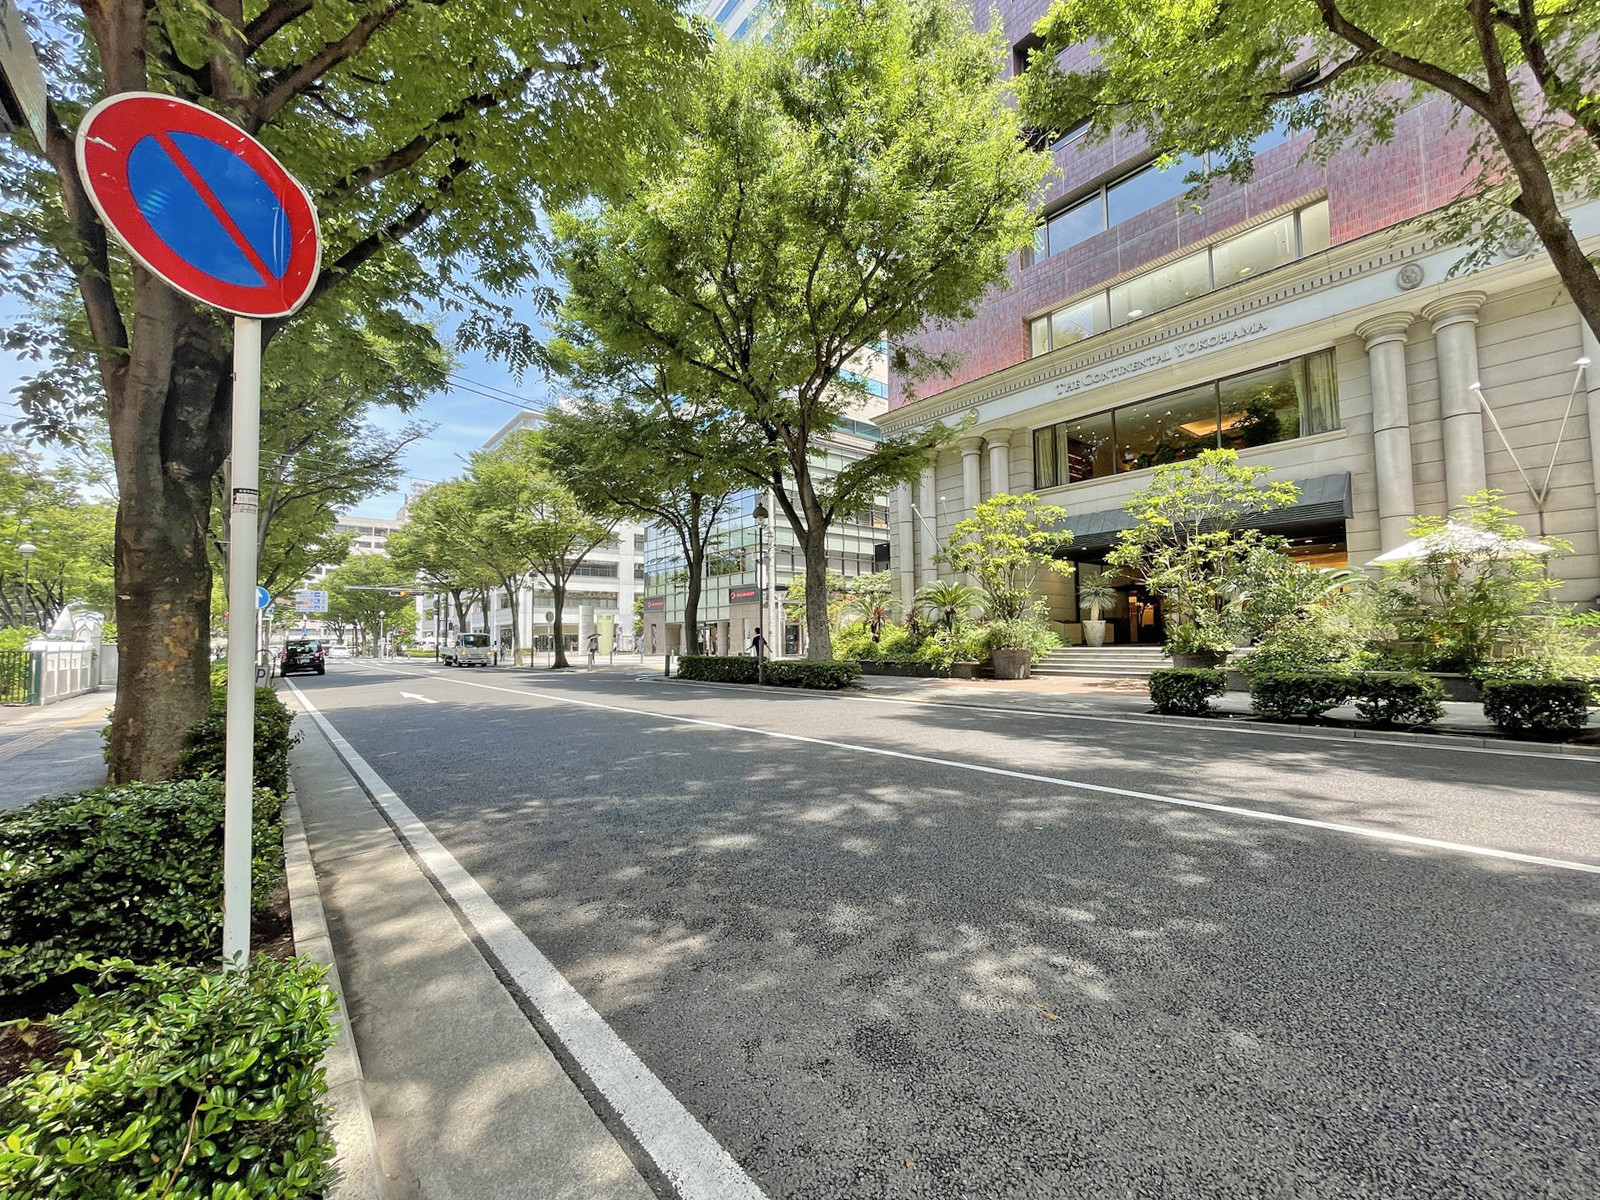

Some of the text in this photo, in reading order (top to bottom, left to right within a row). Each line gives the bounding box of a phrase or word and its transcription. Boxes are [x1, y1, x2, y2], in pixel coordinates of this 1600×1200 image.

[1055, 322, 1267, 395] THE CONTINENTAL YOKOHAMA
[255, 668, 266, 683] P
